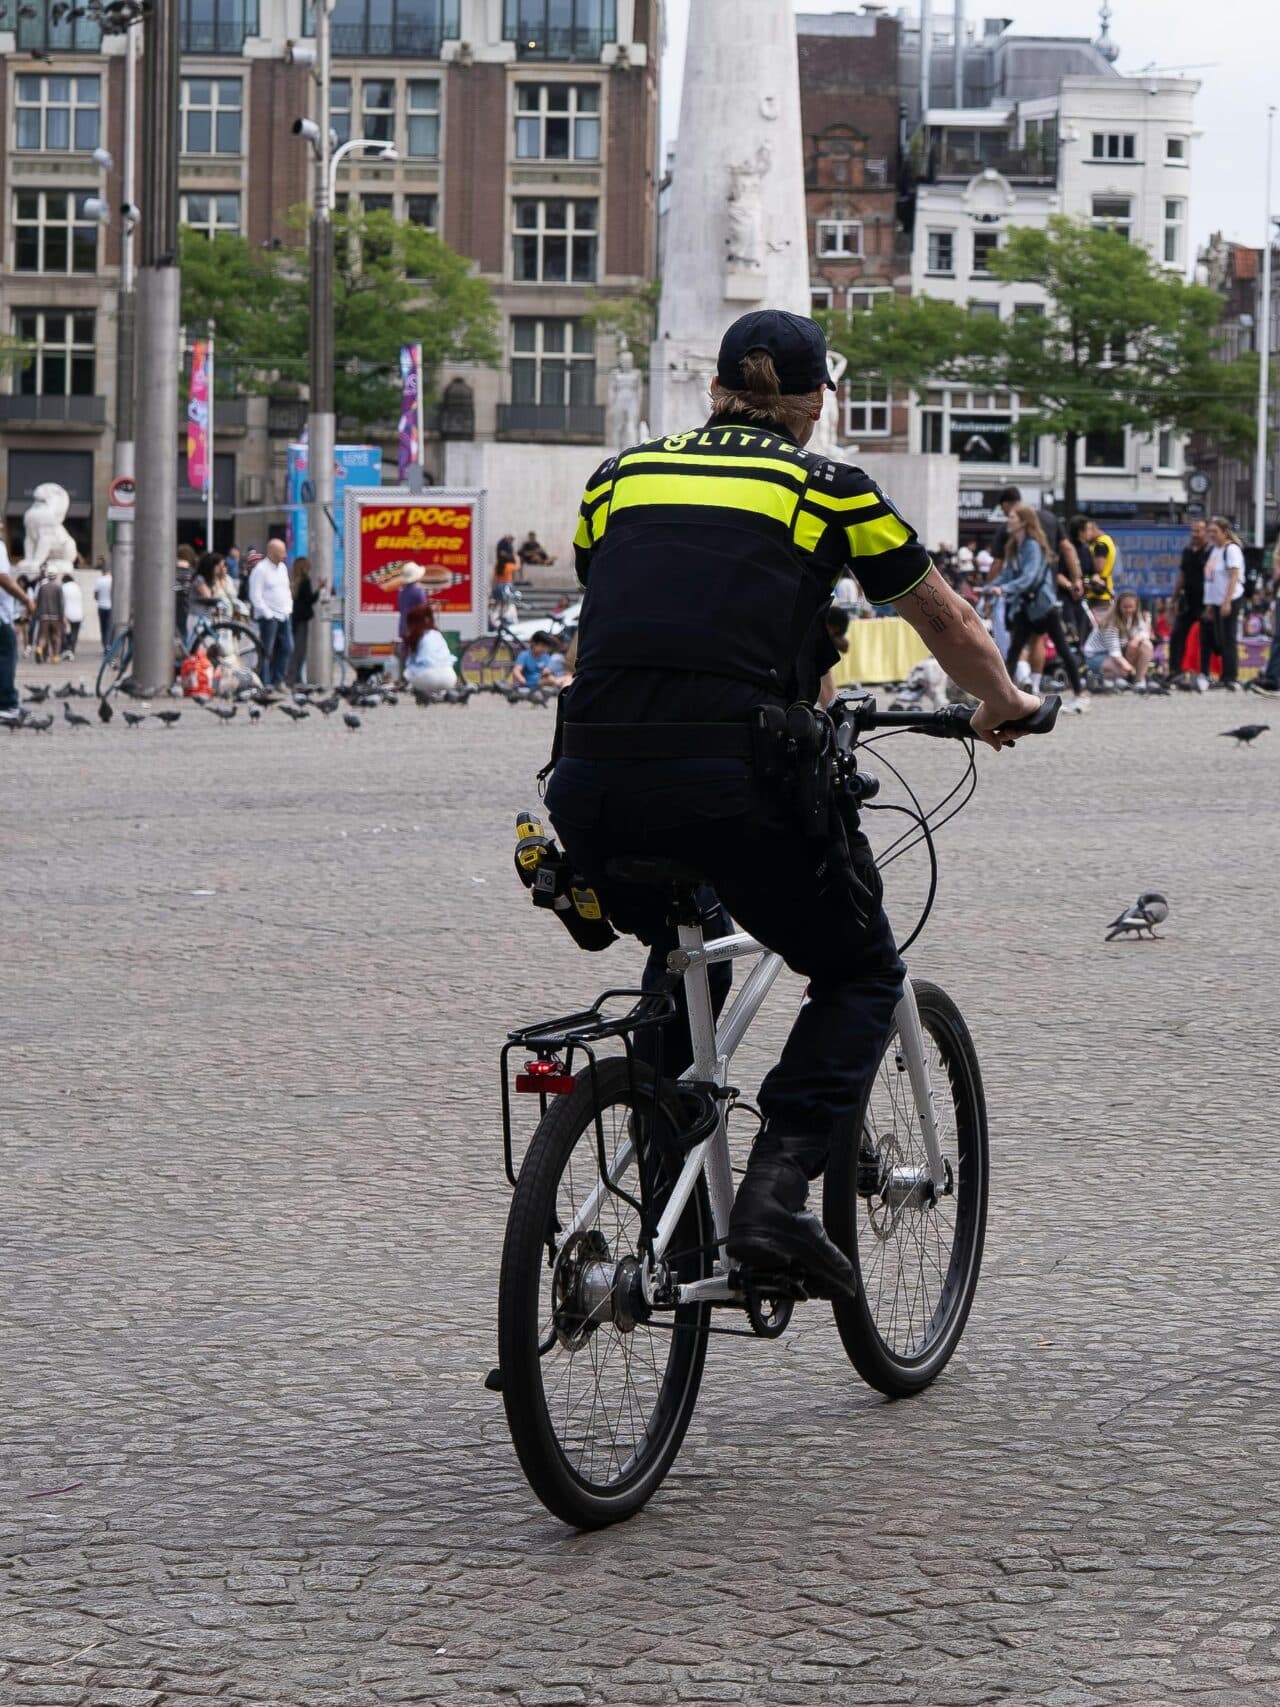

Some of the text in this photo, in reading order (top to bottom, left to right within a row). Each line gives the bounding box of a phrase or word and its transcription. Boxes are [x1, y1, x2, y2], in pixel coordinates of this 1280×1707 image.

[361, 507, 471, 533] HOT DOGS
[374, 535, 464, 551] BURGERS
